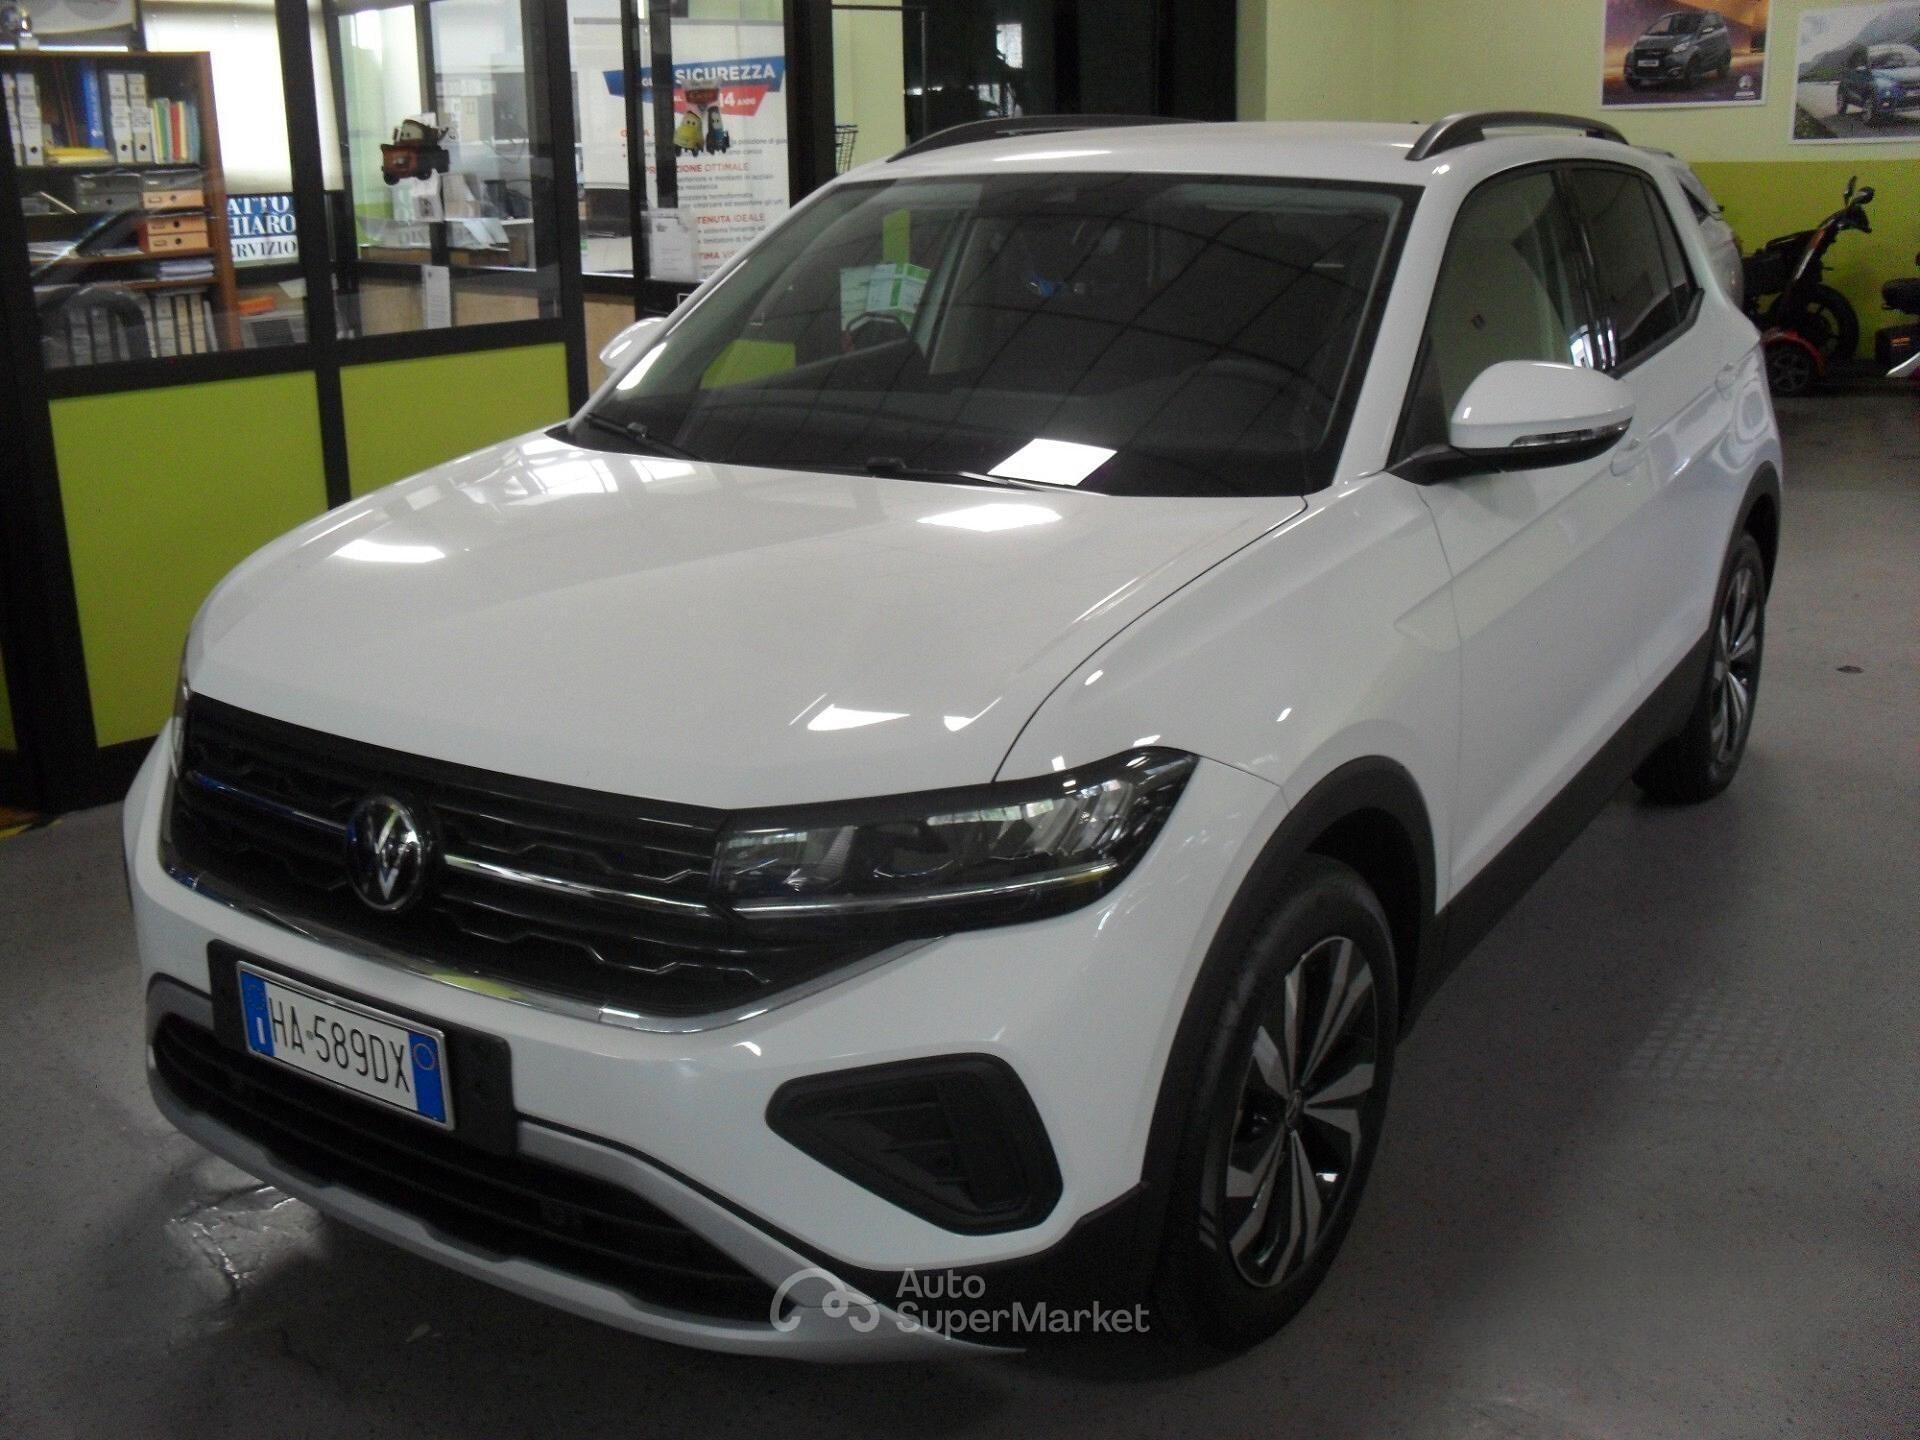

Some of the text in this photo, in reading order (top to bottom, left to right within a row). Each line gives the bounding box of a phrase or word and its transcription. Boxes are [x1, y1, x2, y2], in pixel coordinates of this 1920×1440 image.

[674, 64, 776, 84] SICUREZZA
[704, 162, 749, 172] OTTIMALE
[227, 196, 289, 215] ATTO
[229, 214, 297, 236] HIARO
[696, 212, 766, 225] TENUTA IDEALE
